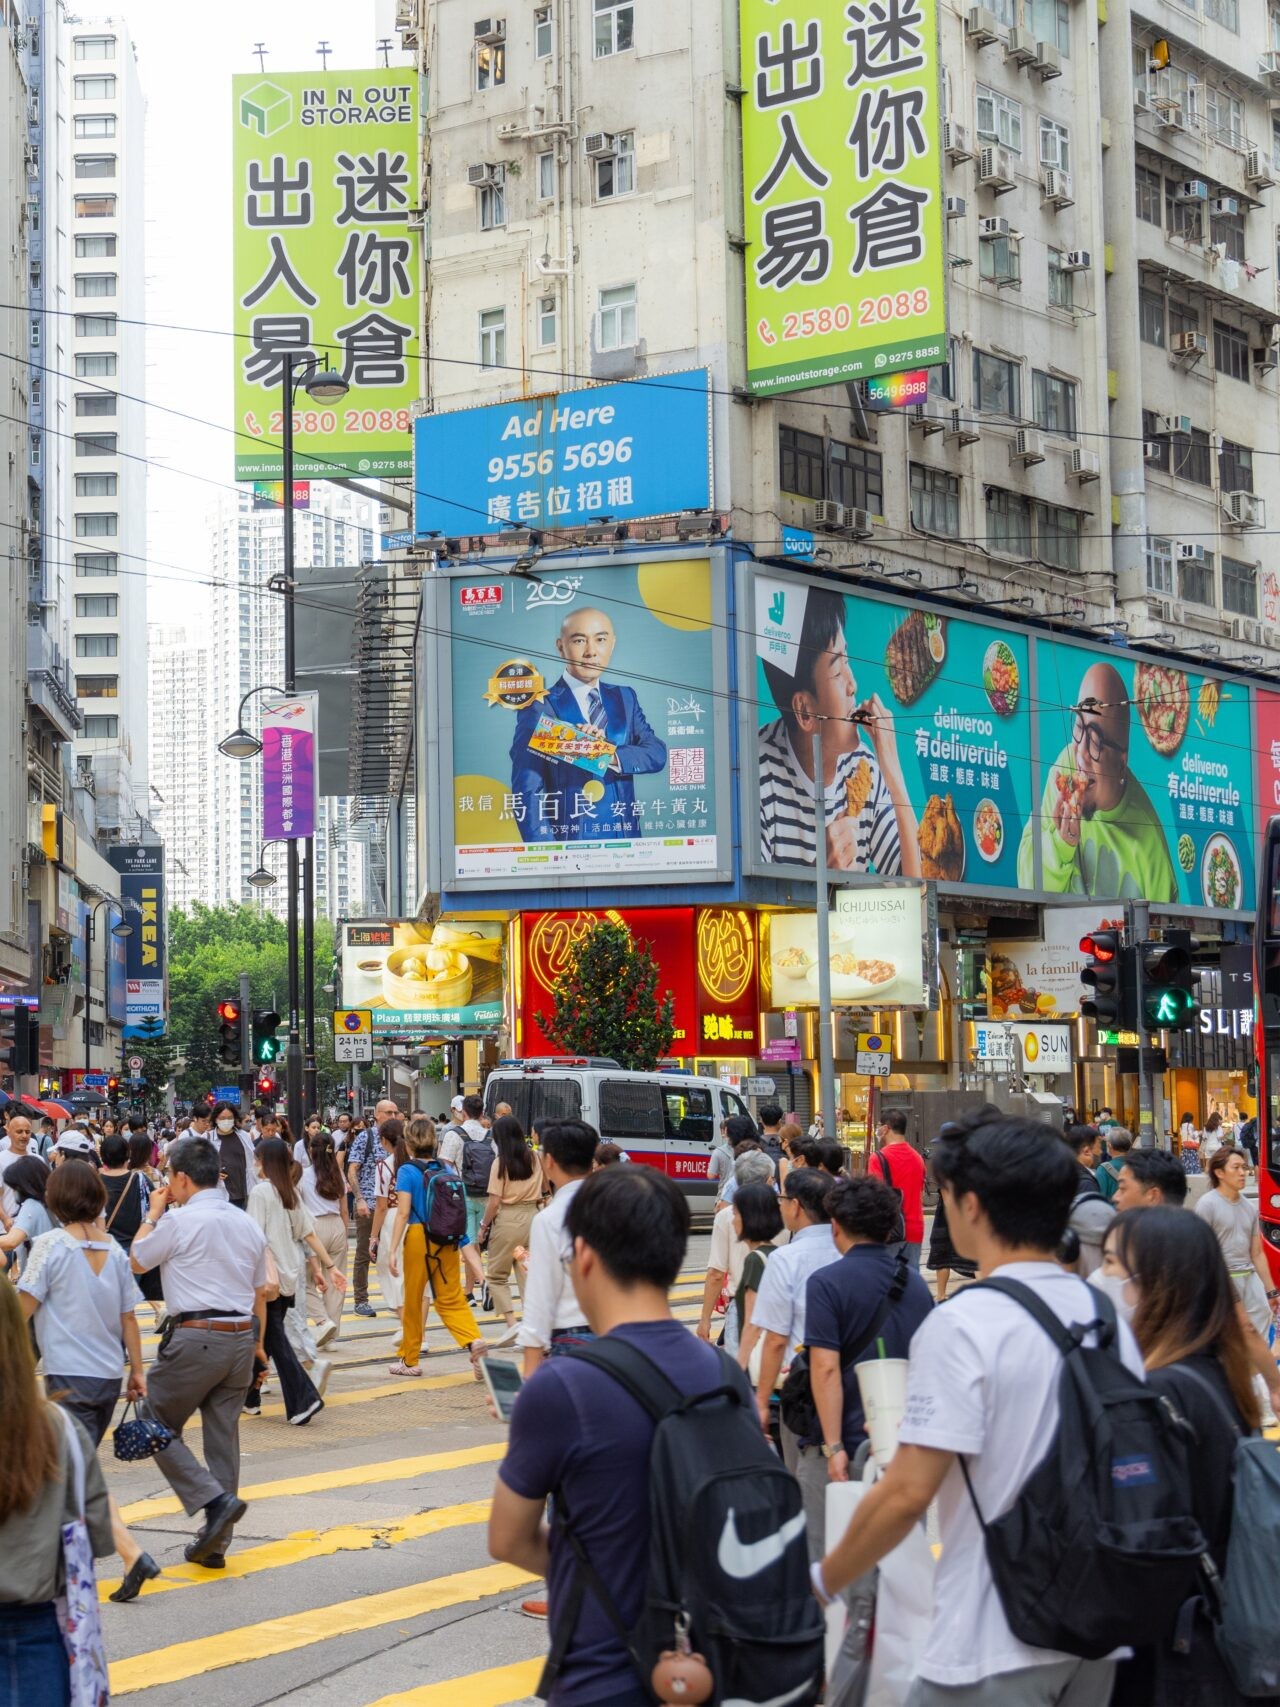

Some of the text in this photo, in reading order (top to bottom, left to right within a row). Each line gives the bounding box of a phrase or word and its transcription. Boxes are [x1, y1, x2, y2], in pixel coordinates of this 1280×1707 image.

[303, 87, 411, 105] IN N OUT
[301, 106, 412, 126] STORAGE
[783, 288, 929, 339] 2580 2088
[752, 346, 941, 390] www.innoutstorage.com 9275 8858
[869, 381, 927, 400] 5649 6988
[344, 409, 410, 433] 2088
[500, 404, 616, 441] Ad Here
[372, 460, 395, 469] 9275
[487, 436, 634, 483] 9556 5696
[487, 475, 635, 525] 廣告位招租
[763, 627, 792, 640] deliveroo
[933, 705, 994, 737] deliveroo
[1181, 751, 1228, 779] deliveroo
[458, 790, 708, 823] 我信 馬百良 安宮牛黃丸
[839, 899, 906, 913] ICHIJUISSAI
[141, 888, 157, 966] IKEA
[1026, 963, 1037, 976] la
[377, 1014, 401, 1023] Plaza
[338, 1037, 368, 1045] 24 hrs
[1041, 1034, 1068, 1053] SUN
[342, 1048, 365, 1060] 全日
[877, 1054, 884, 1062] 7
[1041, 1055, 1069, 1063] MOBILE
[877, 1066, 888, 1075] 12
[682, 1161, 707, 1174] POLICE
